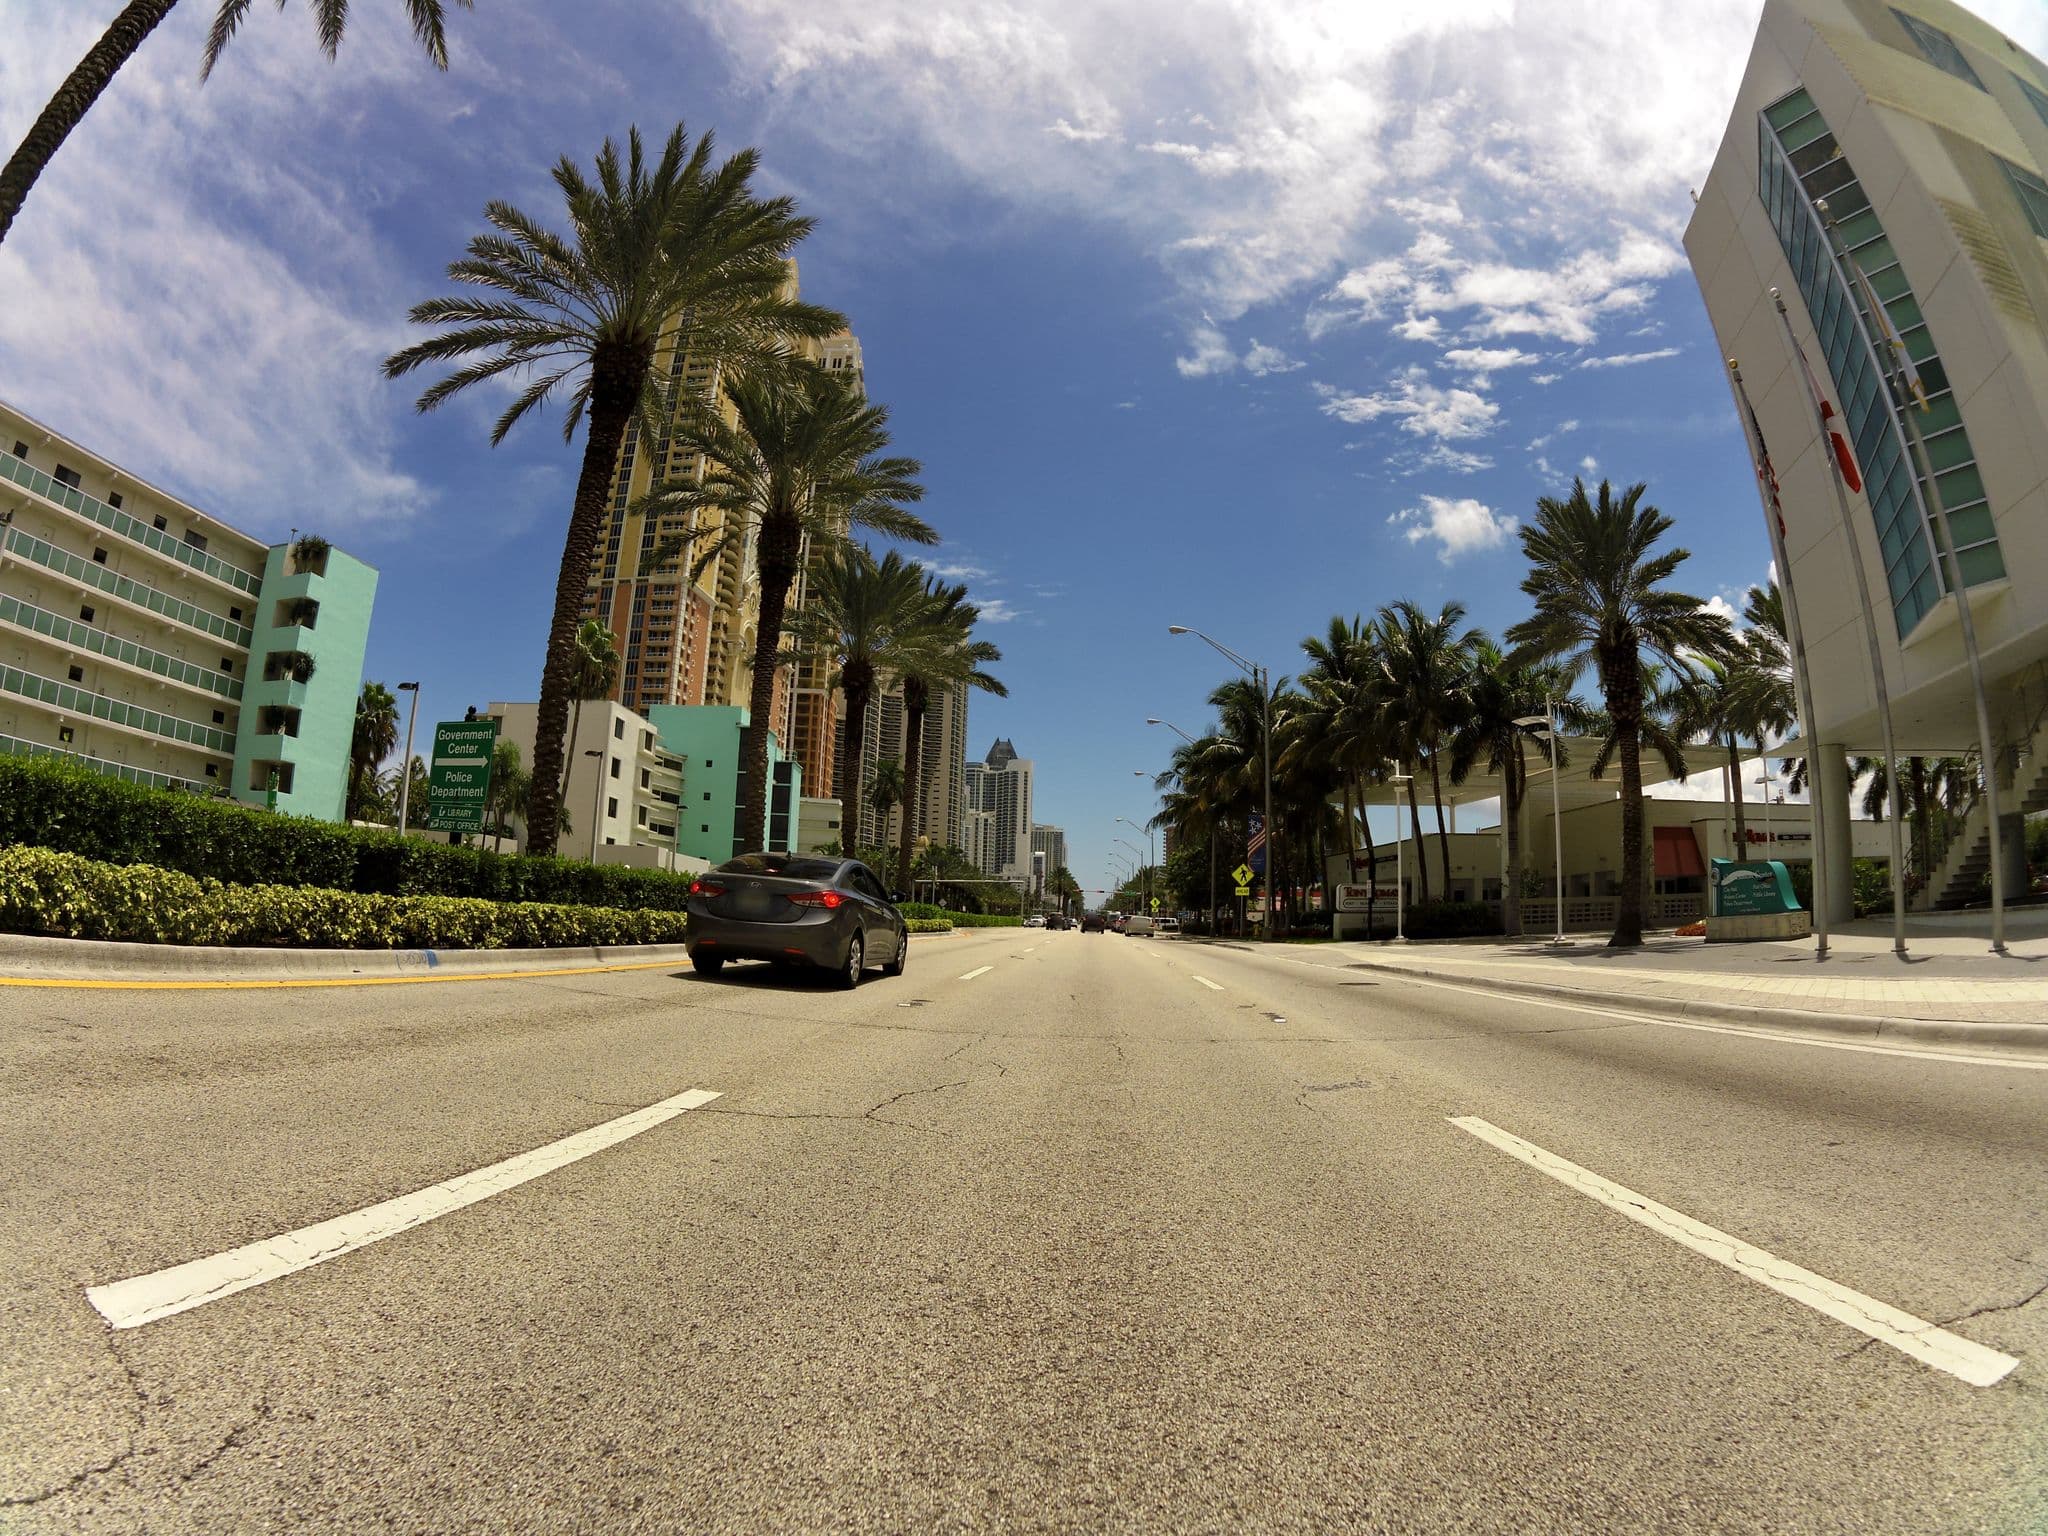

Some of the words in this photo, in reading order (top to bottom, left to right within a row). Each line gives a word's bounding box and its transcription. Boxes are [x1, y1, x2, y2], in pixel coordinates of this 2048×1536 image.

[438, 729, 492, 741] Government
[448, 743, 478, 754] Center
[445, 771, 472, 782] Police
[431, 785, 484, 799] Department
[447, 808, 472, 817] LIBRARY
[439, 820, 455, 829] POST
[457, 821, 479, 830] OFFICE
